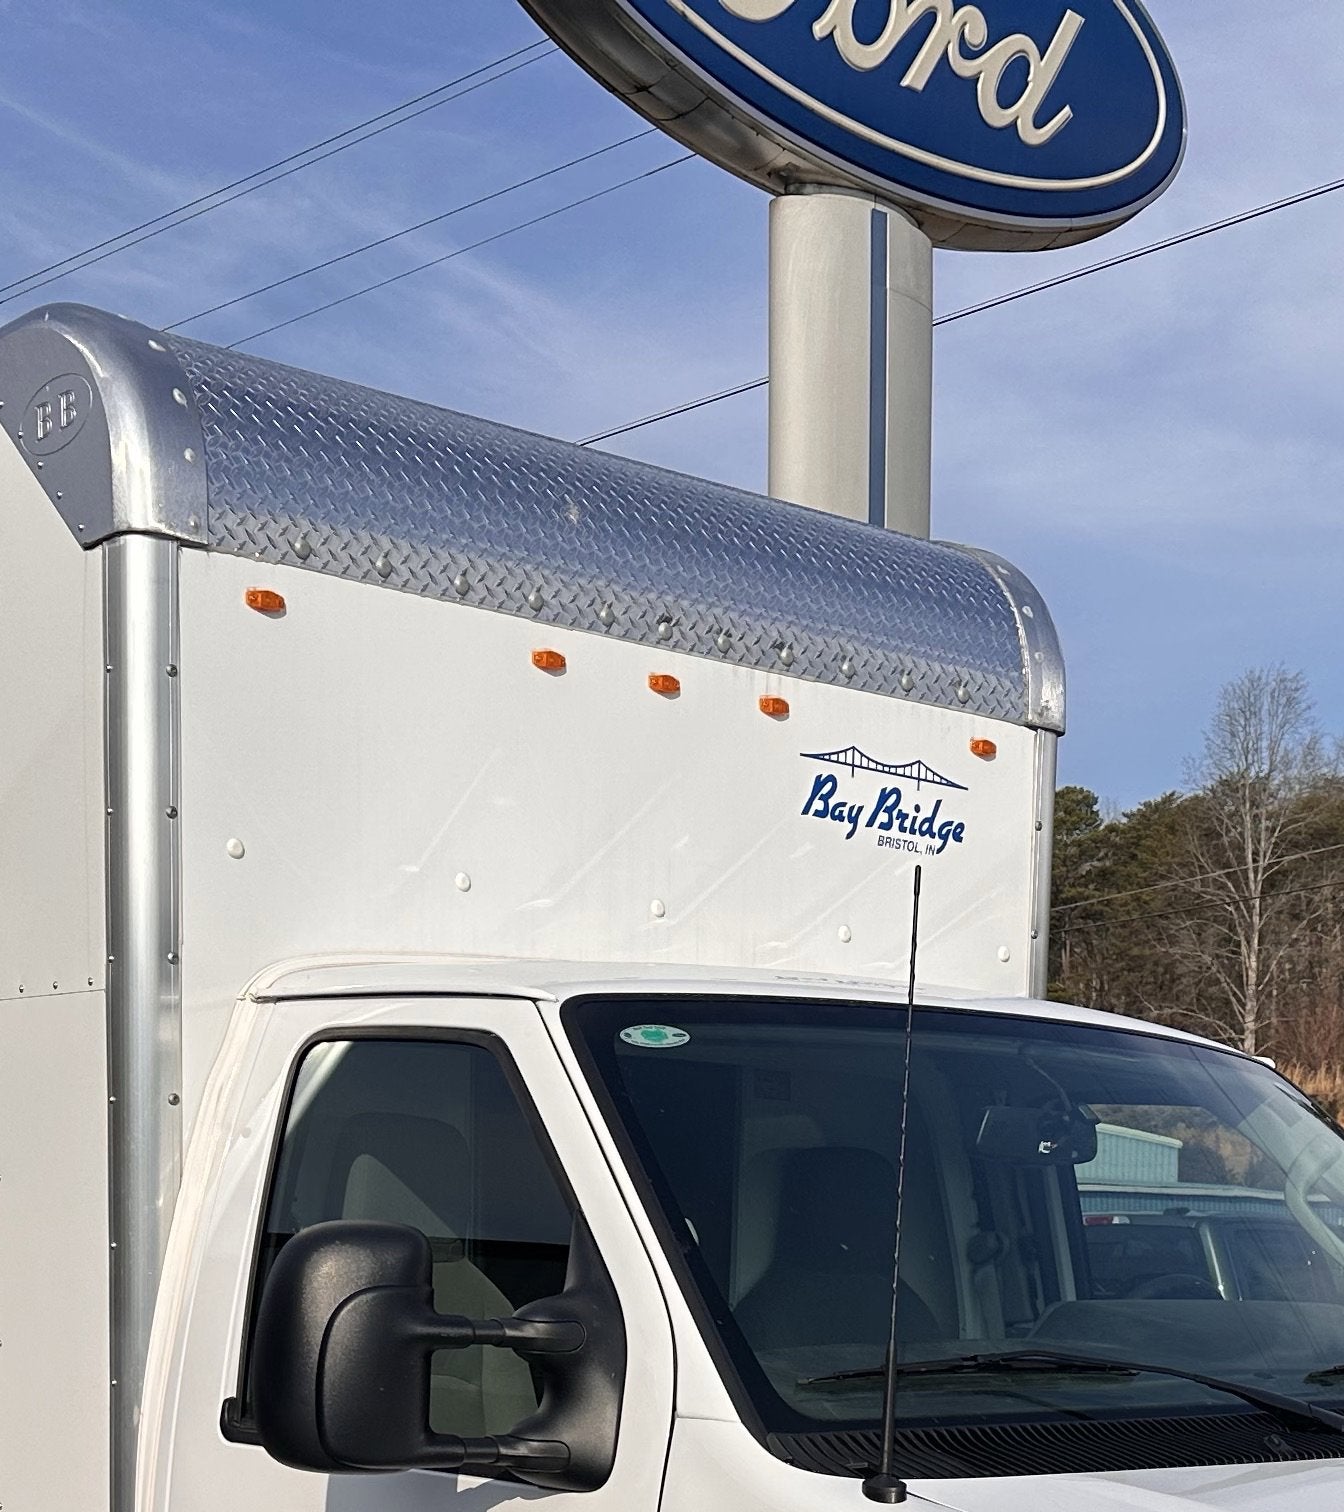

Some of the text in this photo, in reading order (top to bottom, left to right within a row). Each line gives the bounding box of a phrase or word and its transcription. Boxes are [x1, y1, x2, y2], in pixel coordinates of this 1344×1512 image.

[718, 0, 1086, 147] ord
[801, 773, 965, 854] Bay Bridge
[877, 835, 922, 855] BRISTOL,
